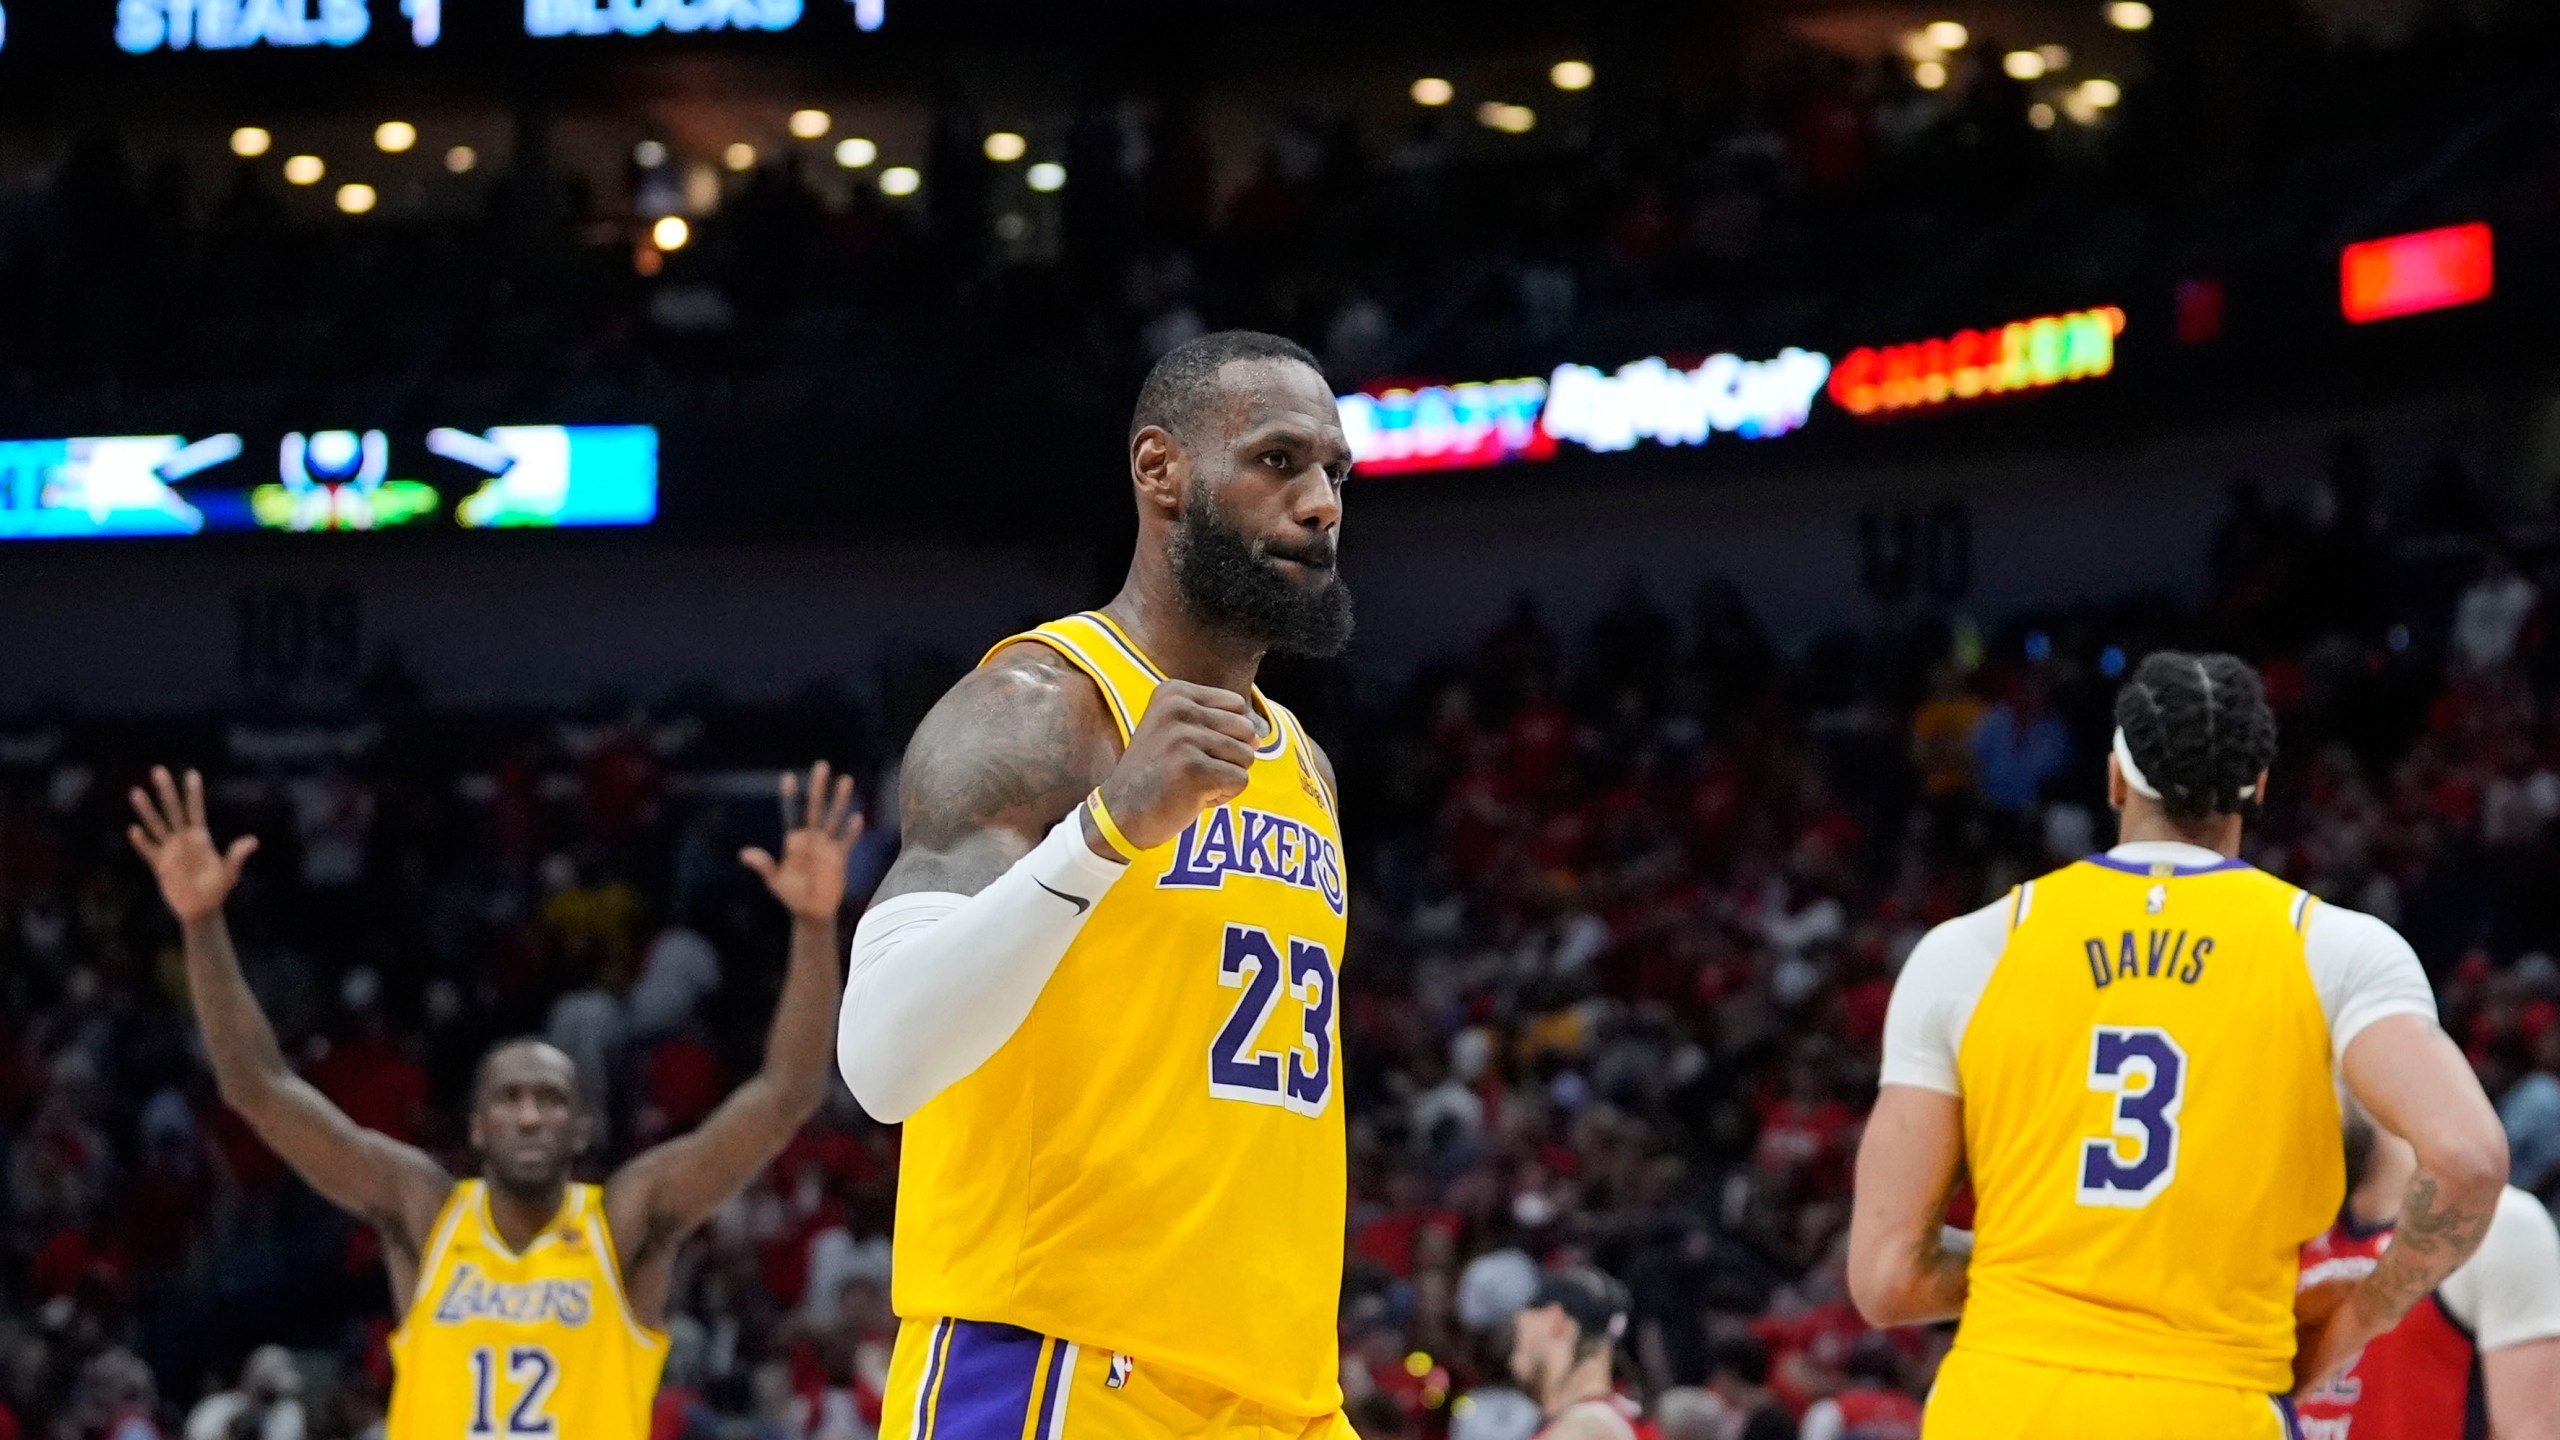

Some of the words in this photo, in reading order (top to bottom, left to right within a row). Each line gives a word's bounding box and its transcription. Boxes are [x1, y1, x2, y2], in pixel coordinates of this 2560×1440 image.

[1156, 804, 1345, 918] LAKERS
[2084, 929, 2215, 989] DAVIS
[1207, 921, 1336, 1119] 23
[2076, 1024, 2188, 1209] 3
[432, 1263, 594, 1328] LAKERS
[468, 1346, 558, 1438] 12
